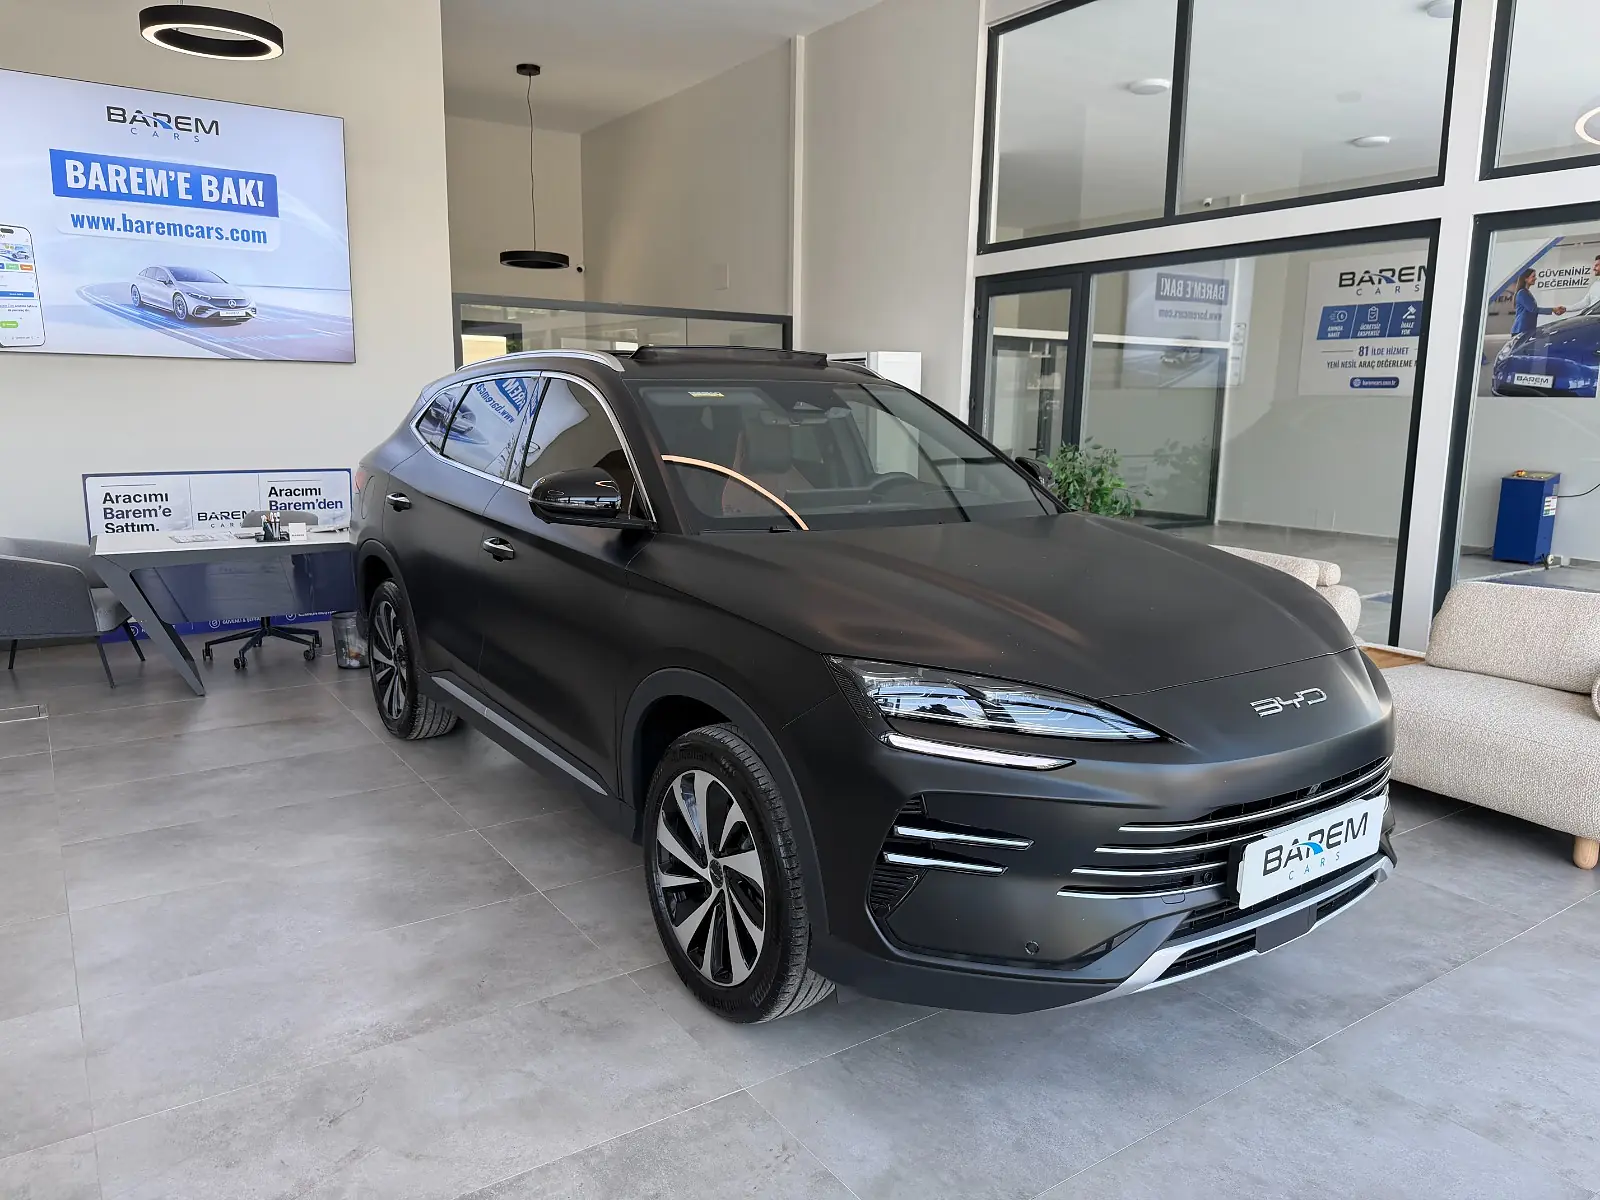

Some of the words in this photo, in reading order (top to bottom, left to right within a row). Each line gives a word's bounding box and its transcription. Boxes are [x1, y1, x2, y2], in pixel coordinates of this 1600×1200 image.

[106, 105, 220, 136] BAREM
[130, 127, 200, 143] CARS
[201, 174, 265, 208] BAK!
[70, 212, 268, 244] www.baremcars.com
[1538, 265, 1592, 278] GÜVENİNİZ
[1537, 276, 1590, 288] DEĞERİMİZ
[1356, 284, 1420, 296] CARS
[1358, 345, 1369, 357] 81
[1371, 346, 1384, 356] İLDE
[1386, 345, 1410, 355] HİZMET
[1327, 359, 1340, 369] YENİ
[1358, 359, 1376, 370] ARAÇ
[1376, 359, 1412, 368] DEĞERLEME
[102, 491, 169, 504] Aracımı
[267, 486, 322, 498] Aracımı
[104, 521, 160, 534] Sattım.
[1249, 687, 1328, 718] BYD
[1262, 811, 1369, 877] BAREM
[1288, 851, 1340, 881] CARS
